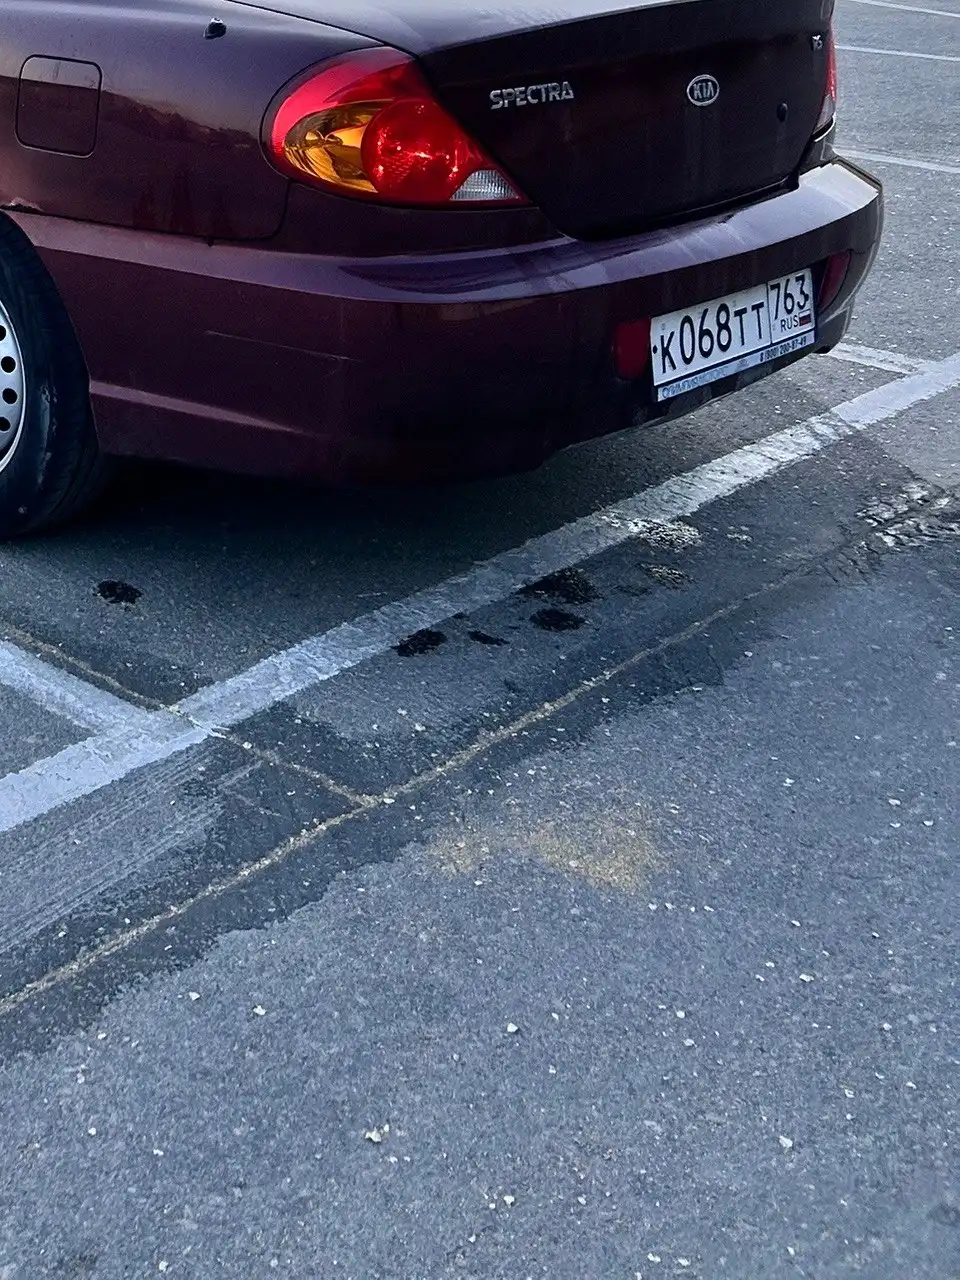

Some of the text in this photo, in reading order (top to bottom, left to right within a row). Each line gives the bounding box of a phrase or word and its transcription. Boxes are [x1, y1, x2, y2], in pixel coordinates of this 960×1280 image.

[490, 81, 575, 110] SPECTRA
[692, 81, 715, 100] KIA
[660, 274, 810, 374] К068ТТ 763
[780, 316, 800, 333] RUS
